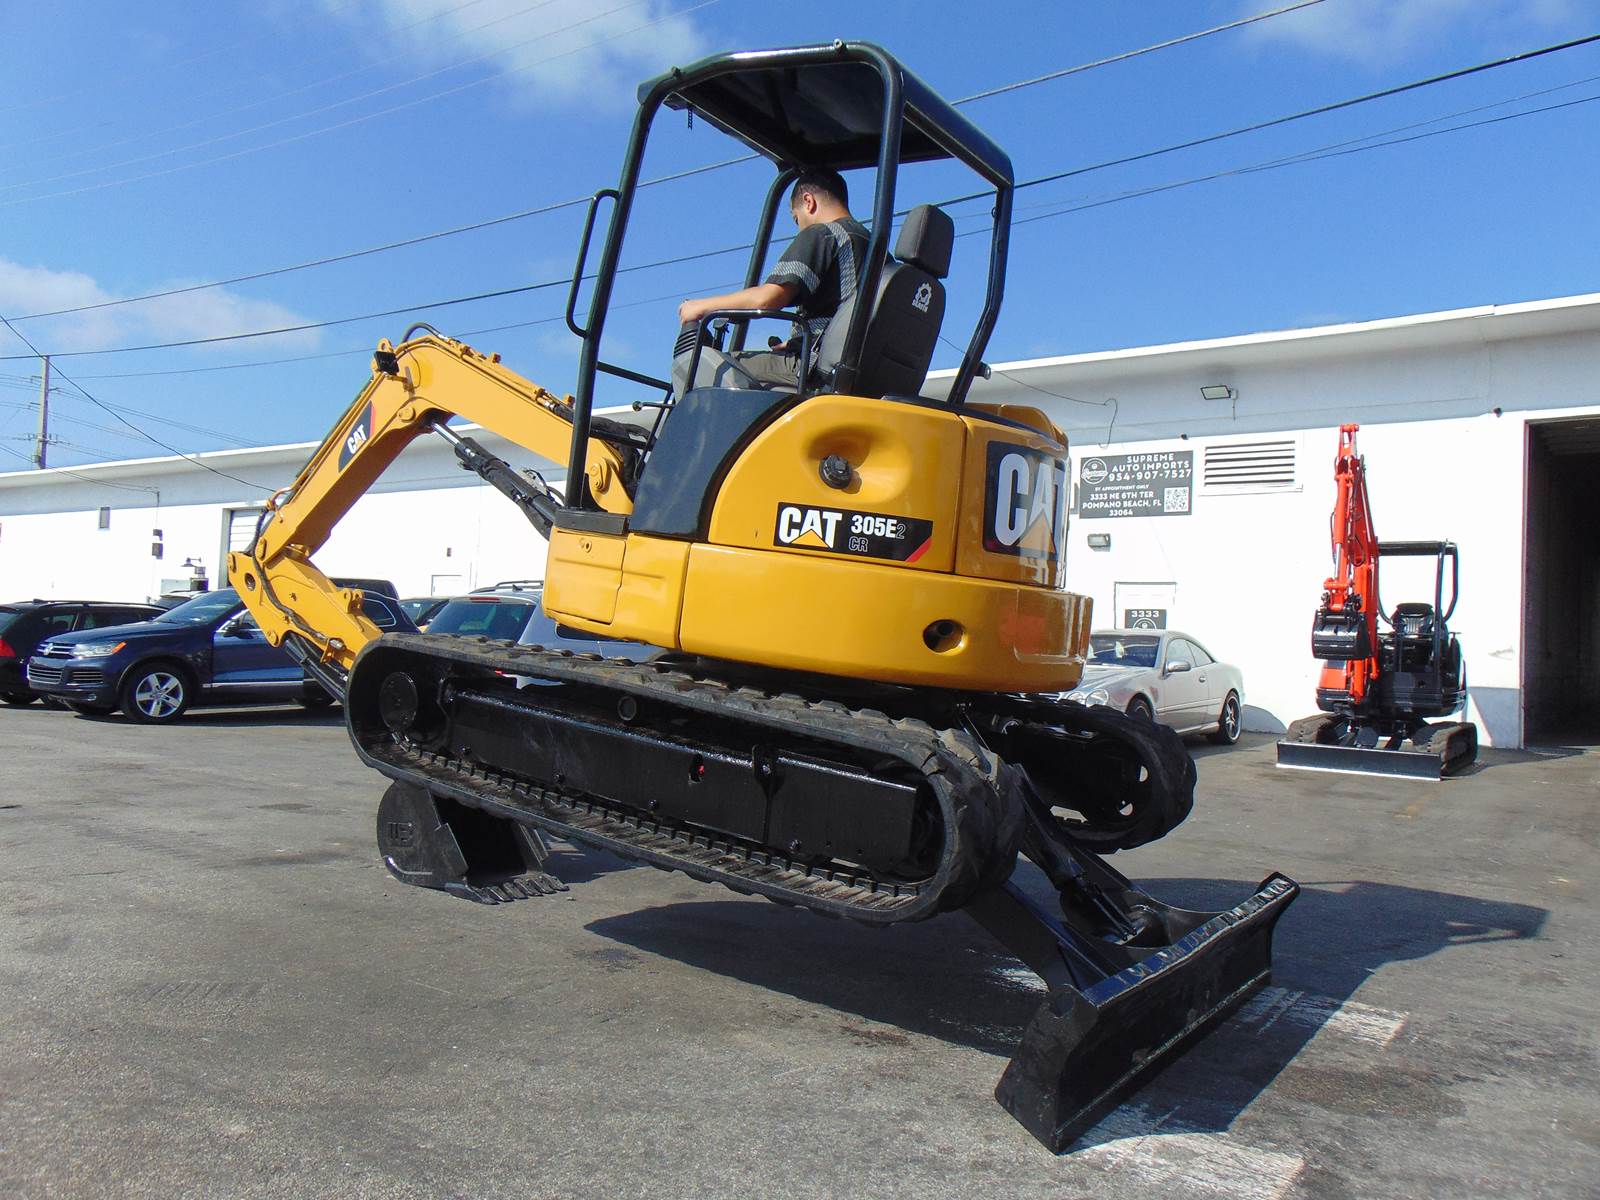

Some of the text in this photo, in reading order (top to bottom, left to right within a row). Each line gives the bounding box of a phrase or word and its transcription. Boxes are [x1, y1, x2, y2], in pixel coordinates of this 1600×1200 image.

[347, 424, 367, 454] CAT
[1127, 453, 1174, 463] SUPREME
[1112, 463, 1140, 473] AUTO
[1143, 461, 1190, 471] IMPORTS
[1108, 469, 1192, 481] 954-907-7527
[1090, 493, 1108, 501] 3333
[1109, 492, 1120, 500] NE
[1121, 491, 1138, 499] 6TH
[995, 453, 1067, 560] CAT
[1082, 501, 1121, 509] POMPANO
[778, 506, 906, 549] CAT 305E2
[848, 536, 868, 552] CR
[1131, 610, 1160, 618] 3333
